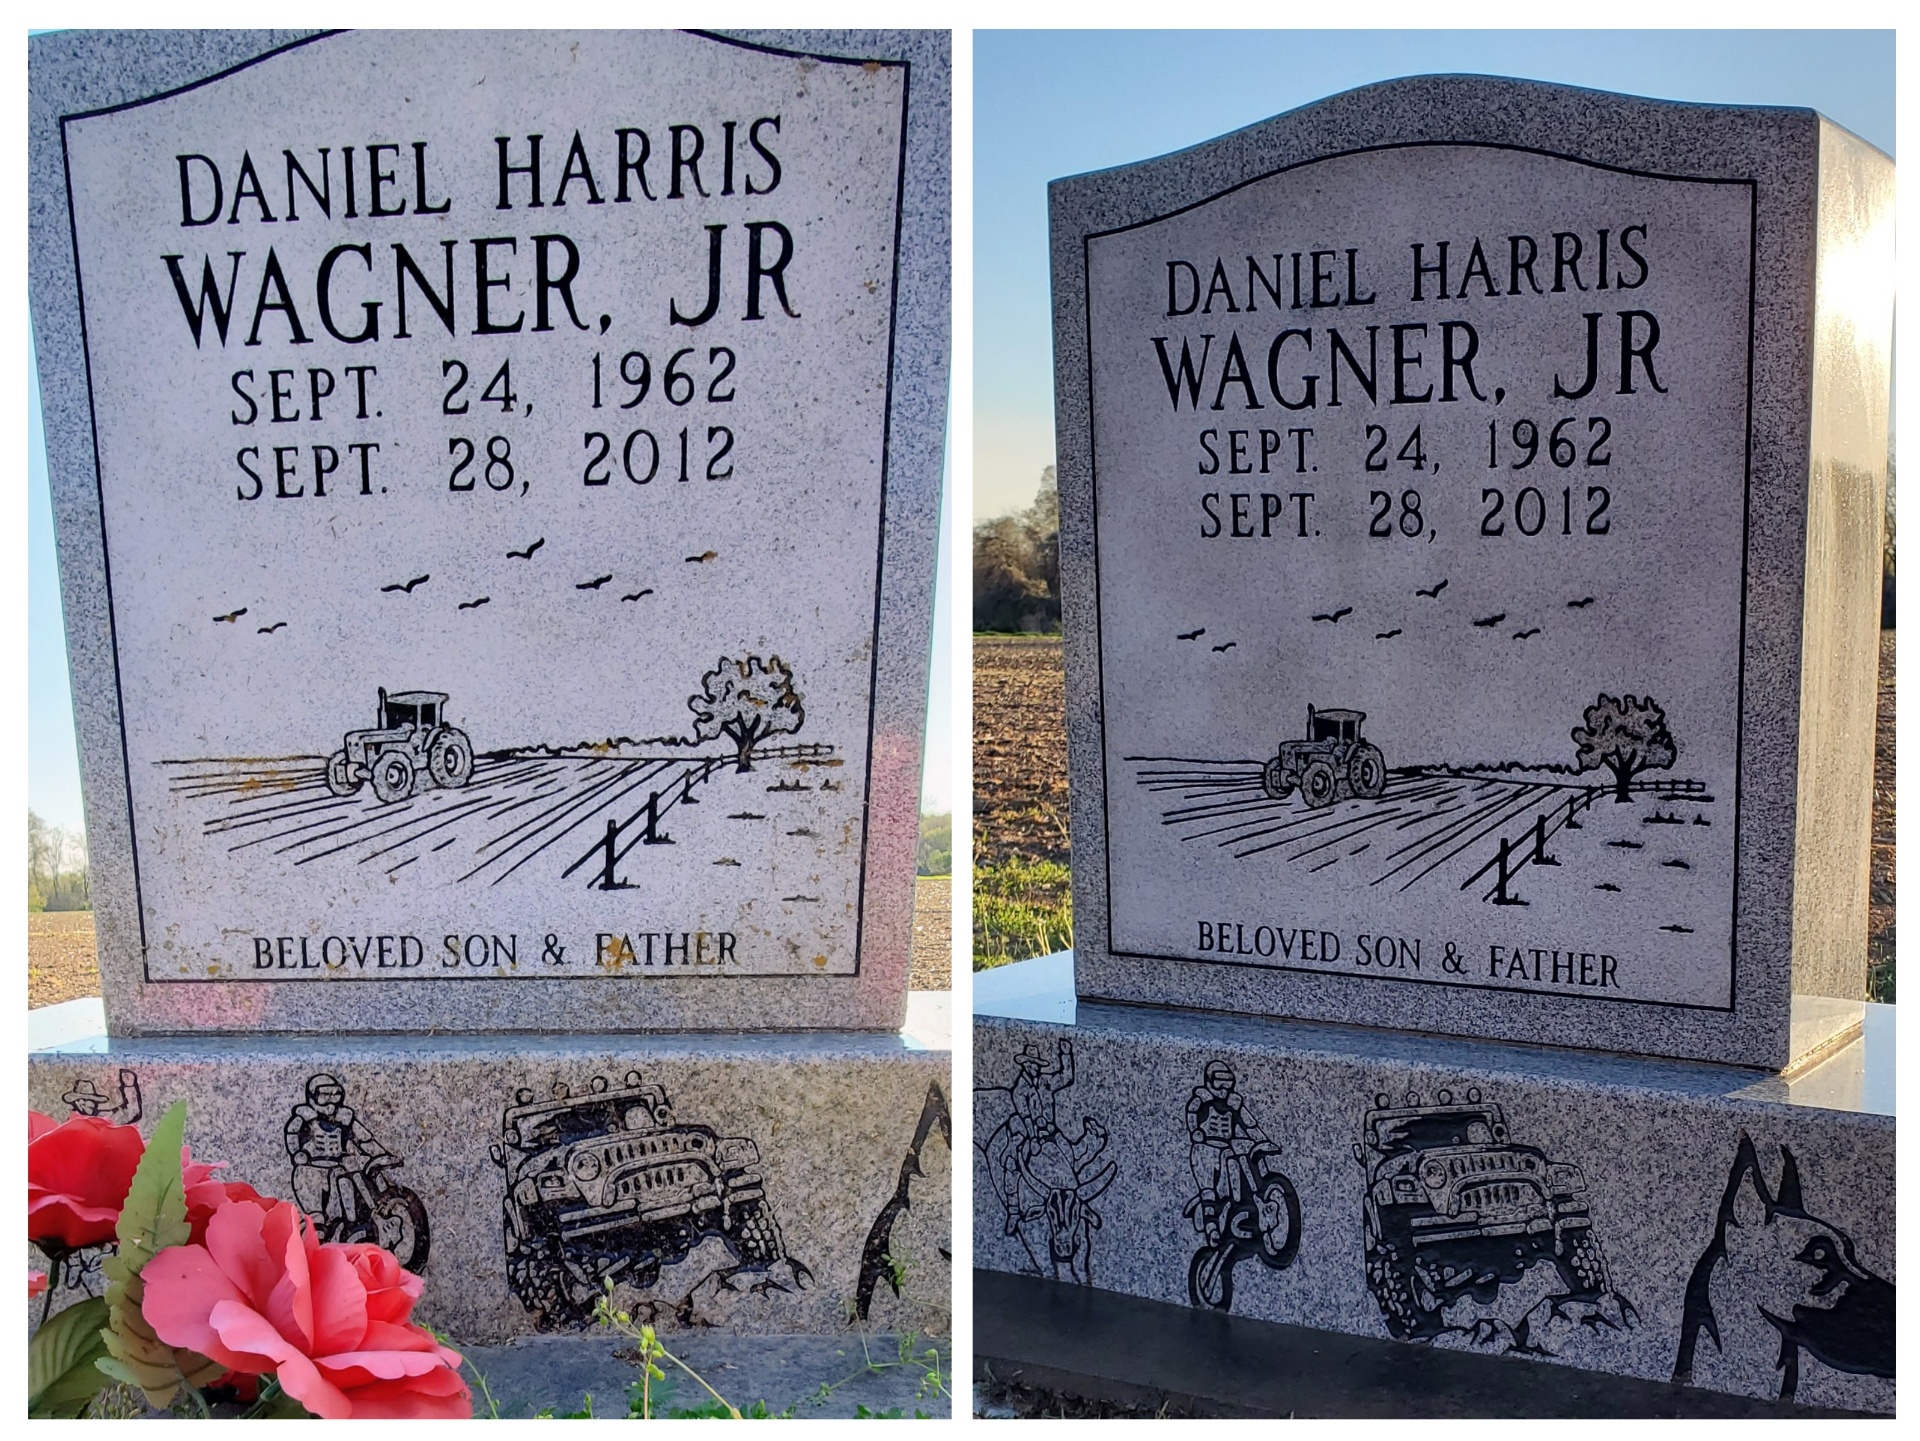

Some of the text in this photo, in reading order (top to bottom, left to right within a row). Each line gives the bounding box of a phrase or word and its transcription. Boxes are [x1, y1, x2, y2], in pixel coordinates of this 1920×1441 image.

[176, 115, 783, 227] DANIEL HARRIS
[160, 220, 801, 349] WAGNER, JR
[1166, 223, 1650, 317] DANIEL HARRIS
[231, 346, 737, 425] SEPT. 24, 1962
[1151, 309, 1668, 412] WAGNER, JR
[236, 425, 736, 501] SEPT. 28, 2012
[1198, 416, 1613, 476] SEPT. 24, 1962
[1200, 485, 1612, 543] SEPT. 28, 2012
[253, 932, 738, 970] BELOVED SON & FATHER
[1198, 920, 1621, 989] BELOVED SON & FATHER
